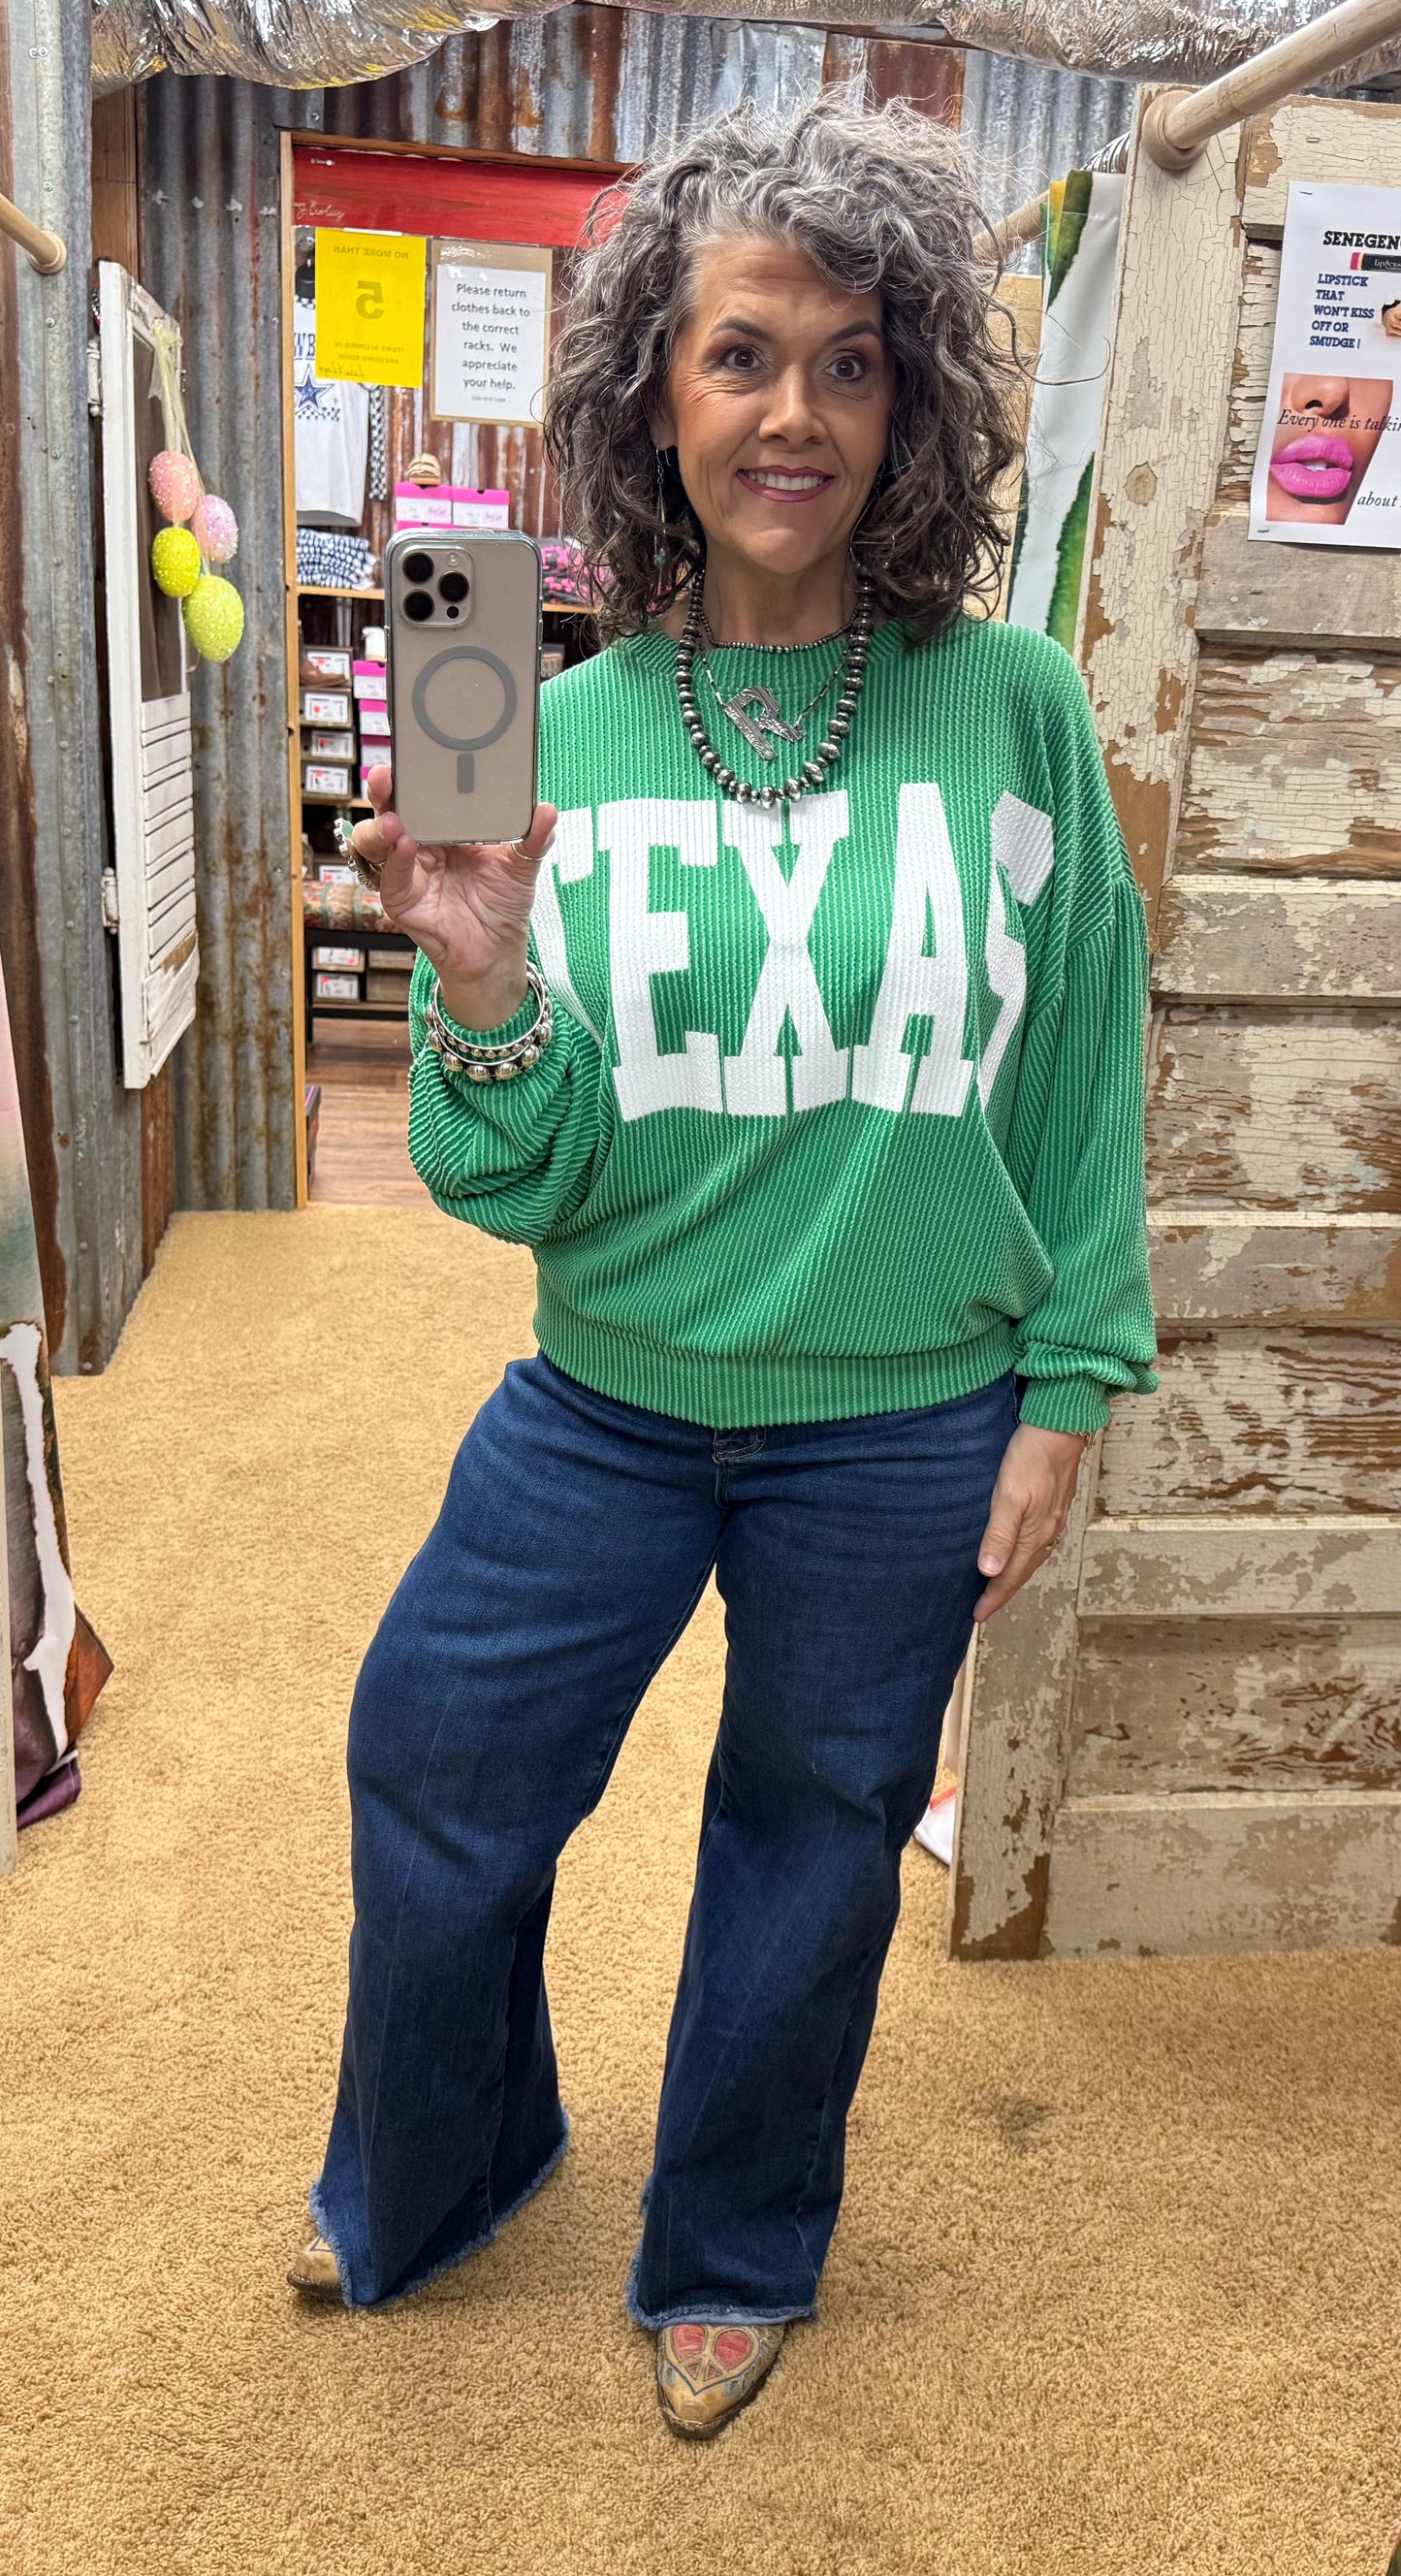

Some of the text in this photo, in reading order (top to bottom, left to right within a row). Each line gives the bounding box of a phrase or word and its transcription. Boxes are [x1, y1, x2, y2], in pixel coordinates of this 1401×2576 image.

[1322, 230, 1401, 249] SENEGEN
[1318, 273, 1369, 287] LIPSTICK
[456, 283, 526, 299] Please return
[1316, 289, 1345, 302] THAT
[451, 302, 530, 317] clothes back to
[1313, 305, 1375, 319] WON'T KISS
[462, 321, 520, 336] the correct
[1311, 320, 1350, 333] OFF OR
[463, 339, 518, 353] racks. We
[1309, 336, 1355, 349] SMUDGE
[462, 360, 518, 371] appreciate
[462, 377, 516, 392] your help.
[1277, 408, 1320, 433] Every
[1321, 417, 1347, 430] one
[1349, 414, 1361, 430] is
[1356, 491, 1398, 507] about
